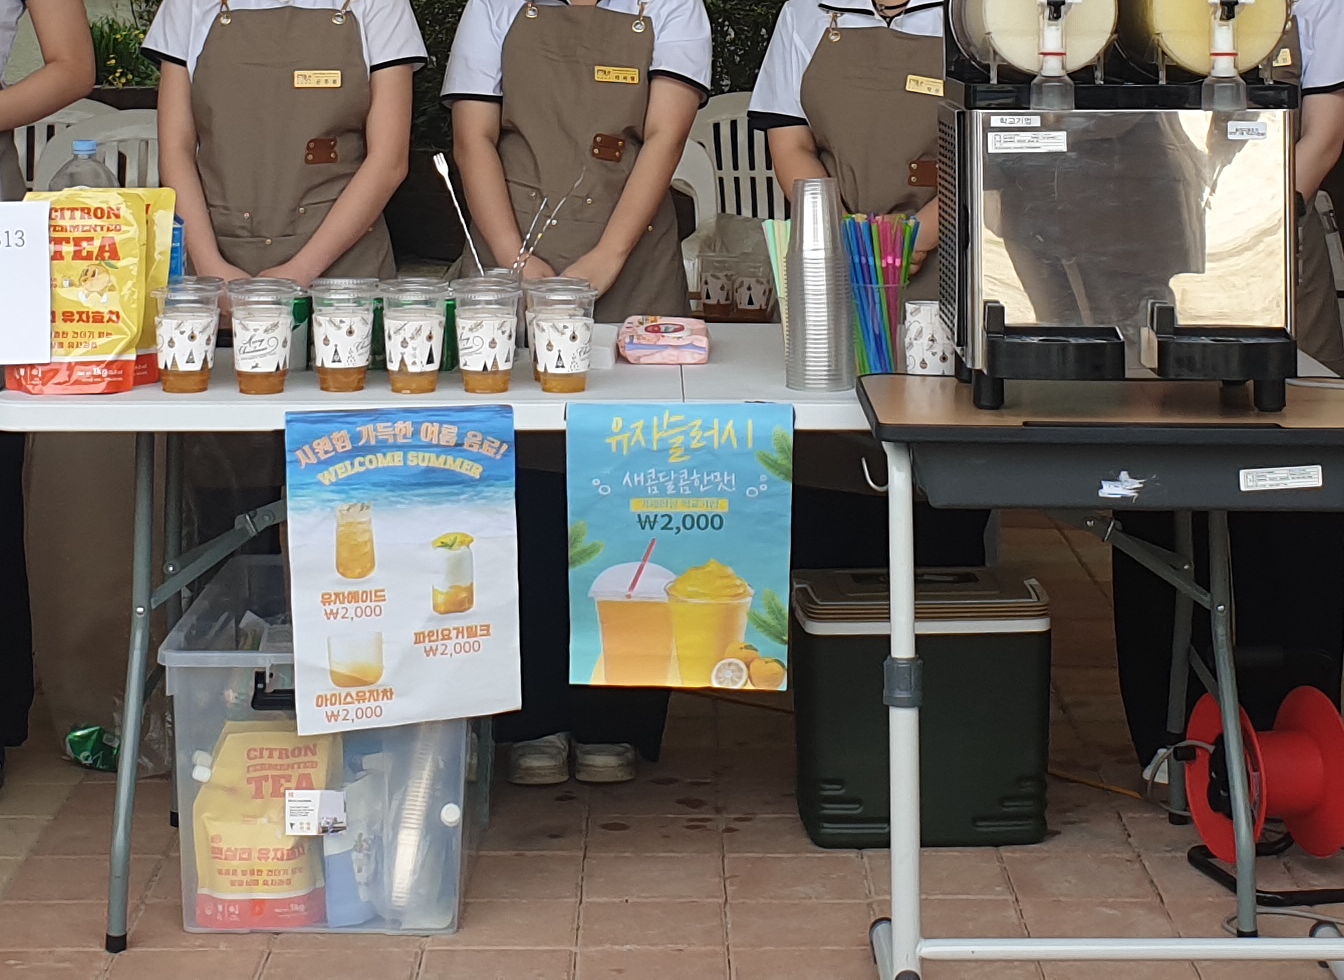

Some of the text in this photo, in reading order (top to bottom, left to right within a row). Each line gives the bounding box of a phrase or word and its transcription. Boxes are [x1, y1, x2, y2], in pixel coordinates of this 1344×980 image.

[49, 206, 122, 220] CITRON
[50, 236, 122, 261] TEA
[355, 421, 414, 446] 가득한
[420, 422, 459, 447] 여름
[605, 409, 754, 463] 유자슬러시
[317, 450, 484, 486] WELCOME SUMMER
[636, 513, 724, 535] ₩2,000
[320, 588, 387, 606] 유자에이드
[324, 605, 383, 622] ₩2,000
[423, 640, 482, 658] ₩2,000
[315, 687, 395, 708] 아이스유자차
[325, 705, 384, 724] ₩2,000
[246, 743, 319, 761] CITRON
[246, 773, 316, 799] TEA
